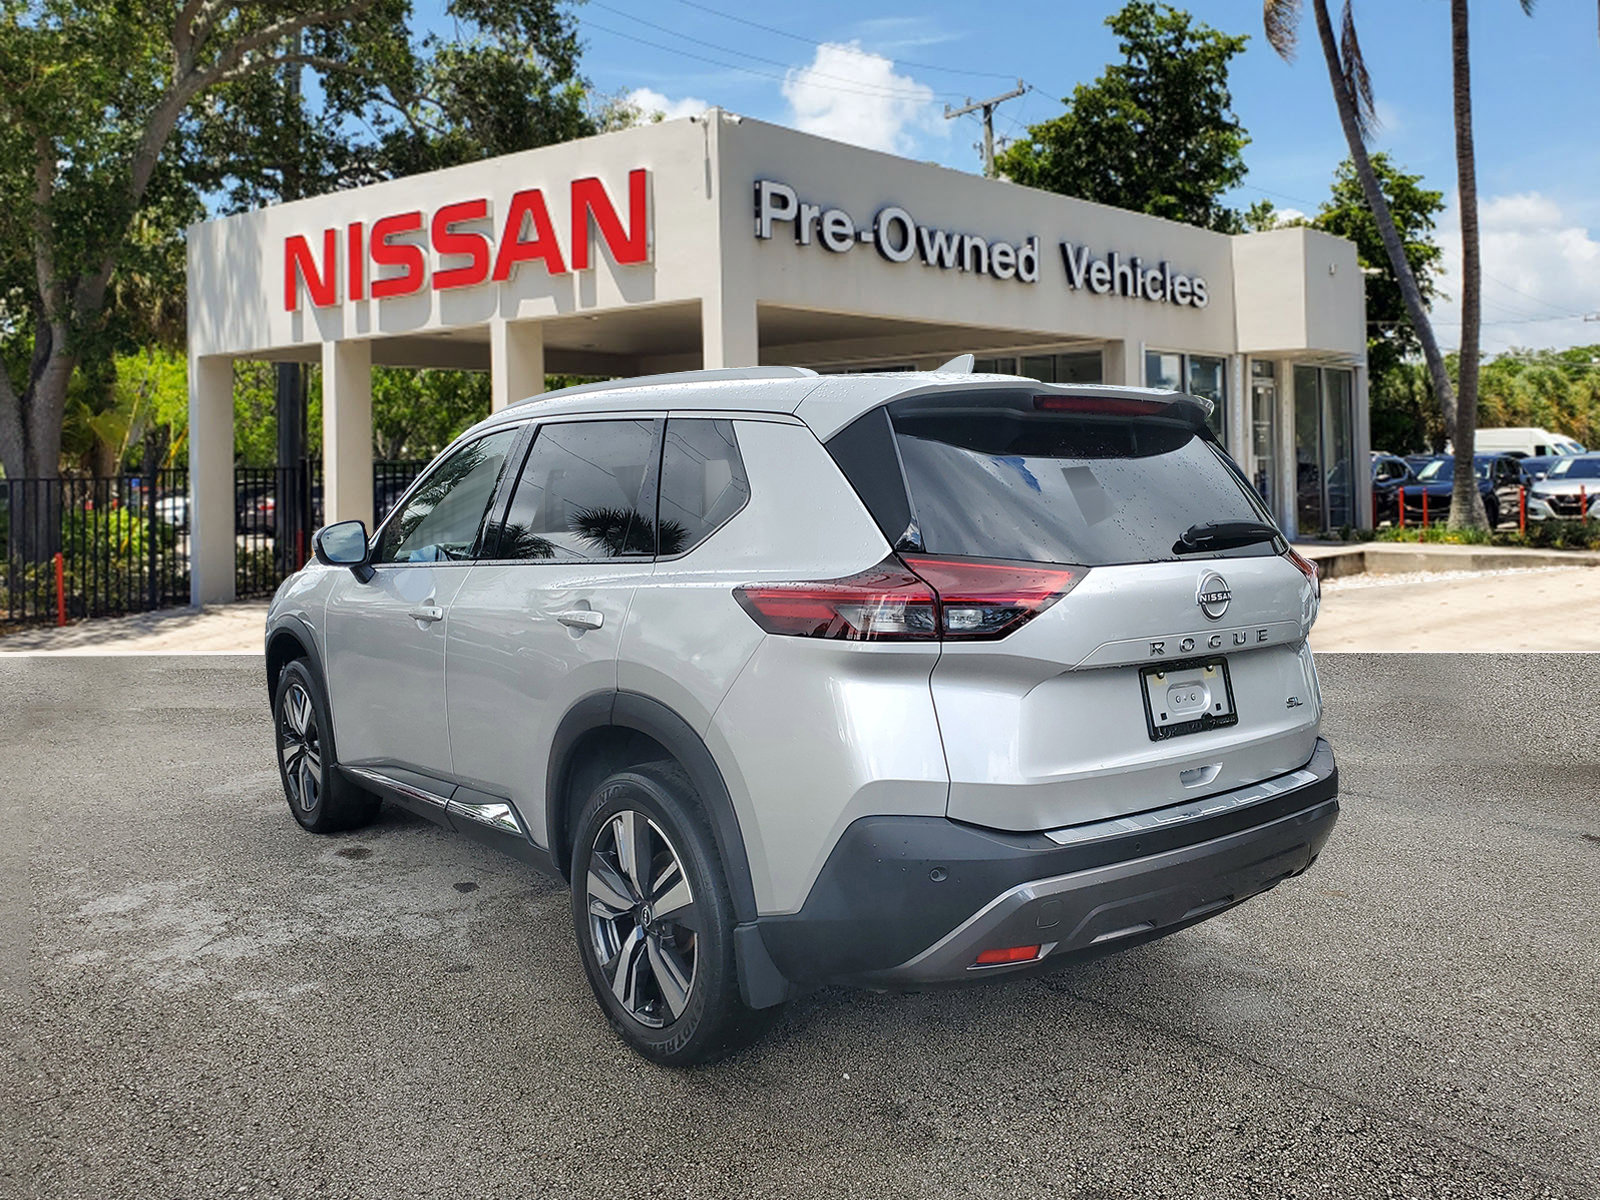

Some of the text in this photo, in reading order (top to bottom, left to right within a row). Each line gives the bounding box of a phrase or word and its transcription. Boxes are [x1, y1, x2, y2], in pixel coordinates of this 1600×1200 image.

[285, 168, 648, 311] NISSAN
[754, 180, 1209, 308] Pre-Owned Vehicles
[1199, 591, 1232, 602] NISSAN
[1149, 629, 1269, 656] ROGUE
[1285, 696, 1303, 709] SL
